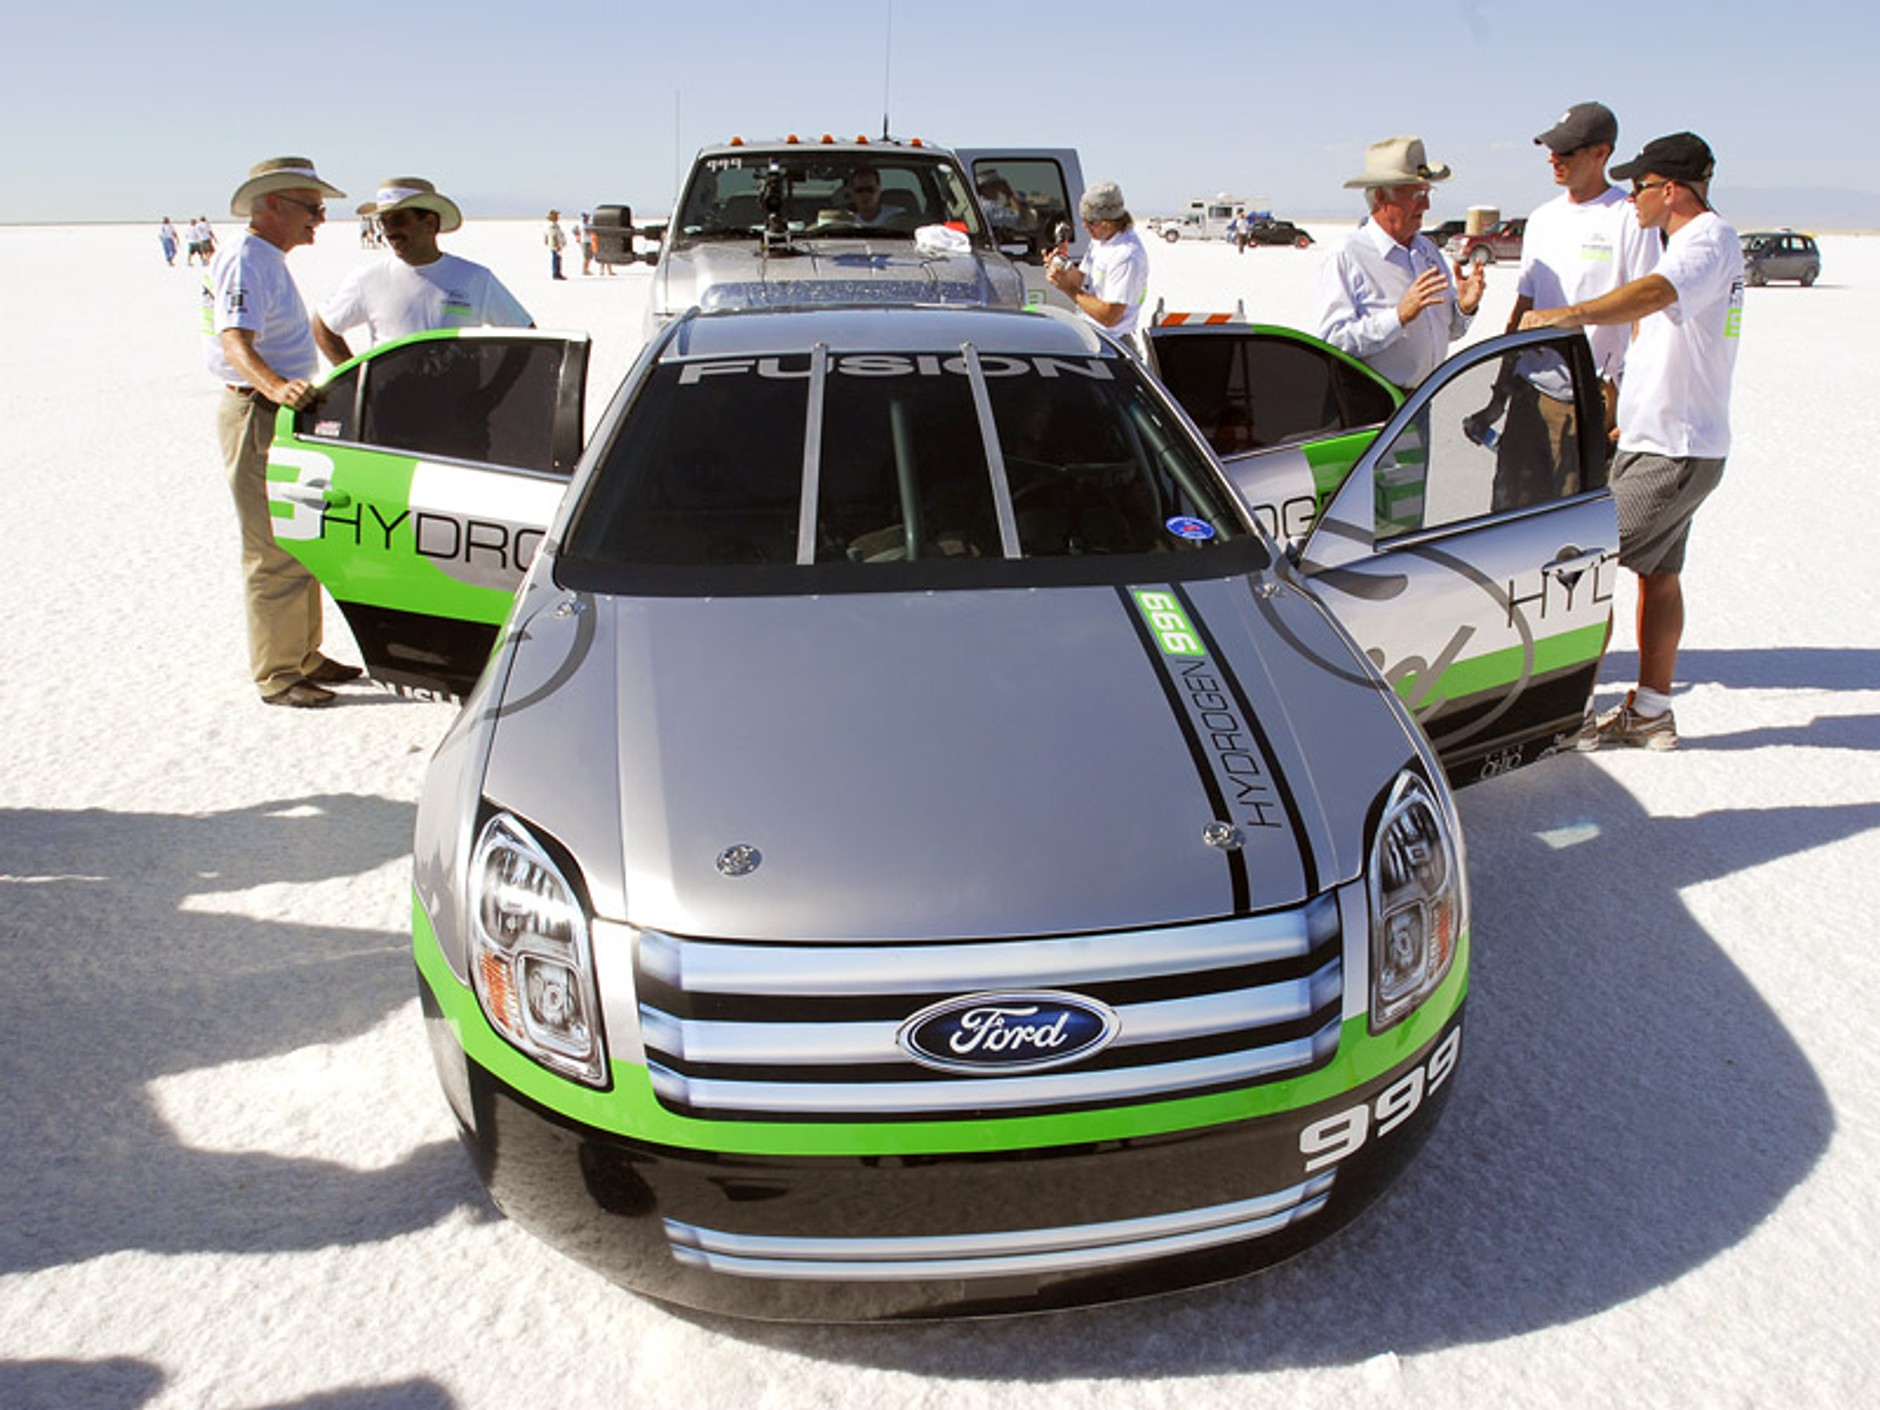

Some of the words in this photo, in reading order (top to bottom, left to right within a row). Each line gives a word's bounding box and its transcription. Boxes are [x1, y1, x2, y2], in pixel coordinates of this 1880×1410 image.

[678, 355, 1115, 385] FUSION
[1175, 658, 1283, 828] HYDROGEN
[949, 1005, 1068, 1054] Ford
[1299, 1025, 1460, 1172] 999
